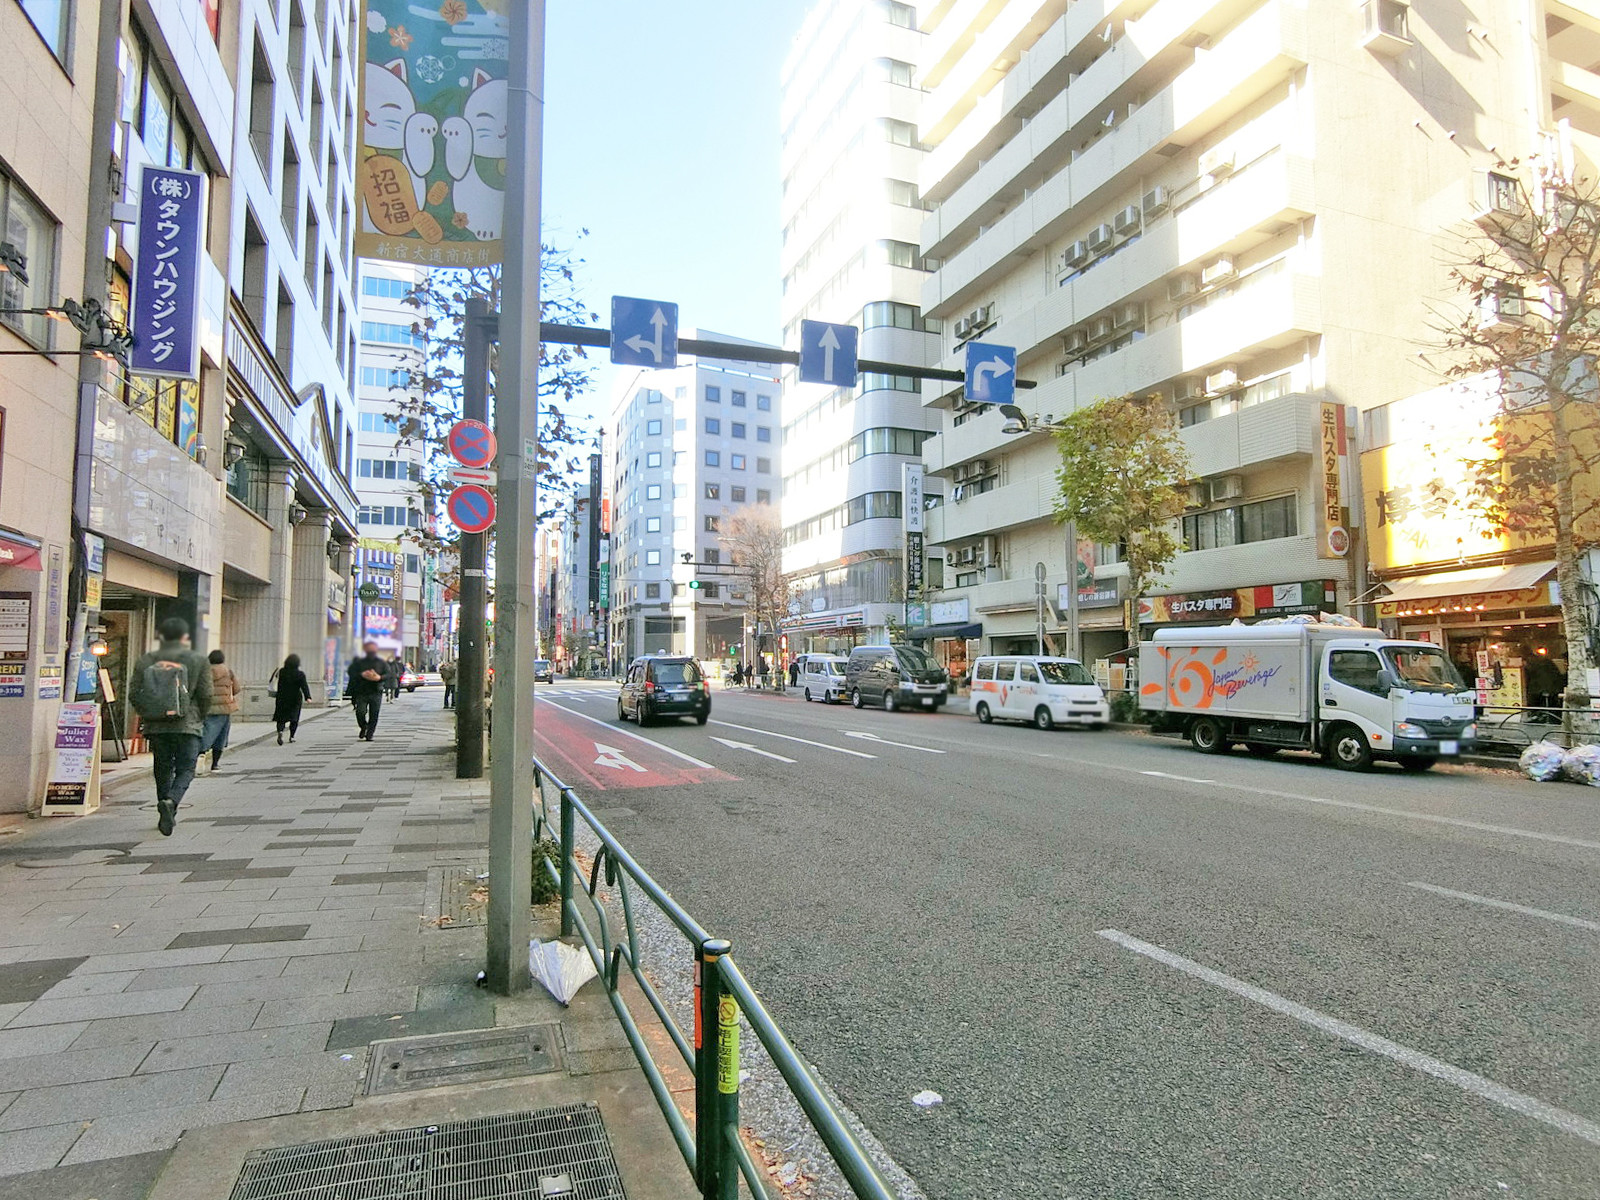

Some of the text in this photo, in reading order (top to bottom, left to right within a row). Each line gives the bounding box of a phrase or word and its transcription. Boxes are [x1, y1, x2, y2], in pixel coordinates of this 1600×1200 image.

[370, 168, 411, 225] 招福
[149, 176, 191, 364] (株)タウンハウジング
[1322, 408, 1339, 522] 生パスタ専門店
[1171, 597, 1233, 614] 生パスタ専門店
[0, 664, 24, 674] ENT
[1208, 666, 1244, 697] Japan
[1226, 665, 1282, 699] Beverage
[62, 727, 89, 736] Juliet
[64, 735, 85, 743] Wax
